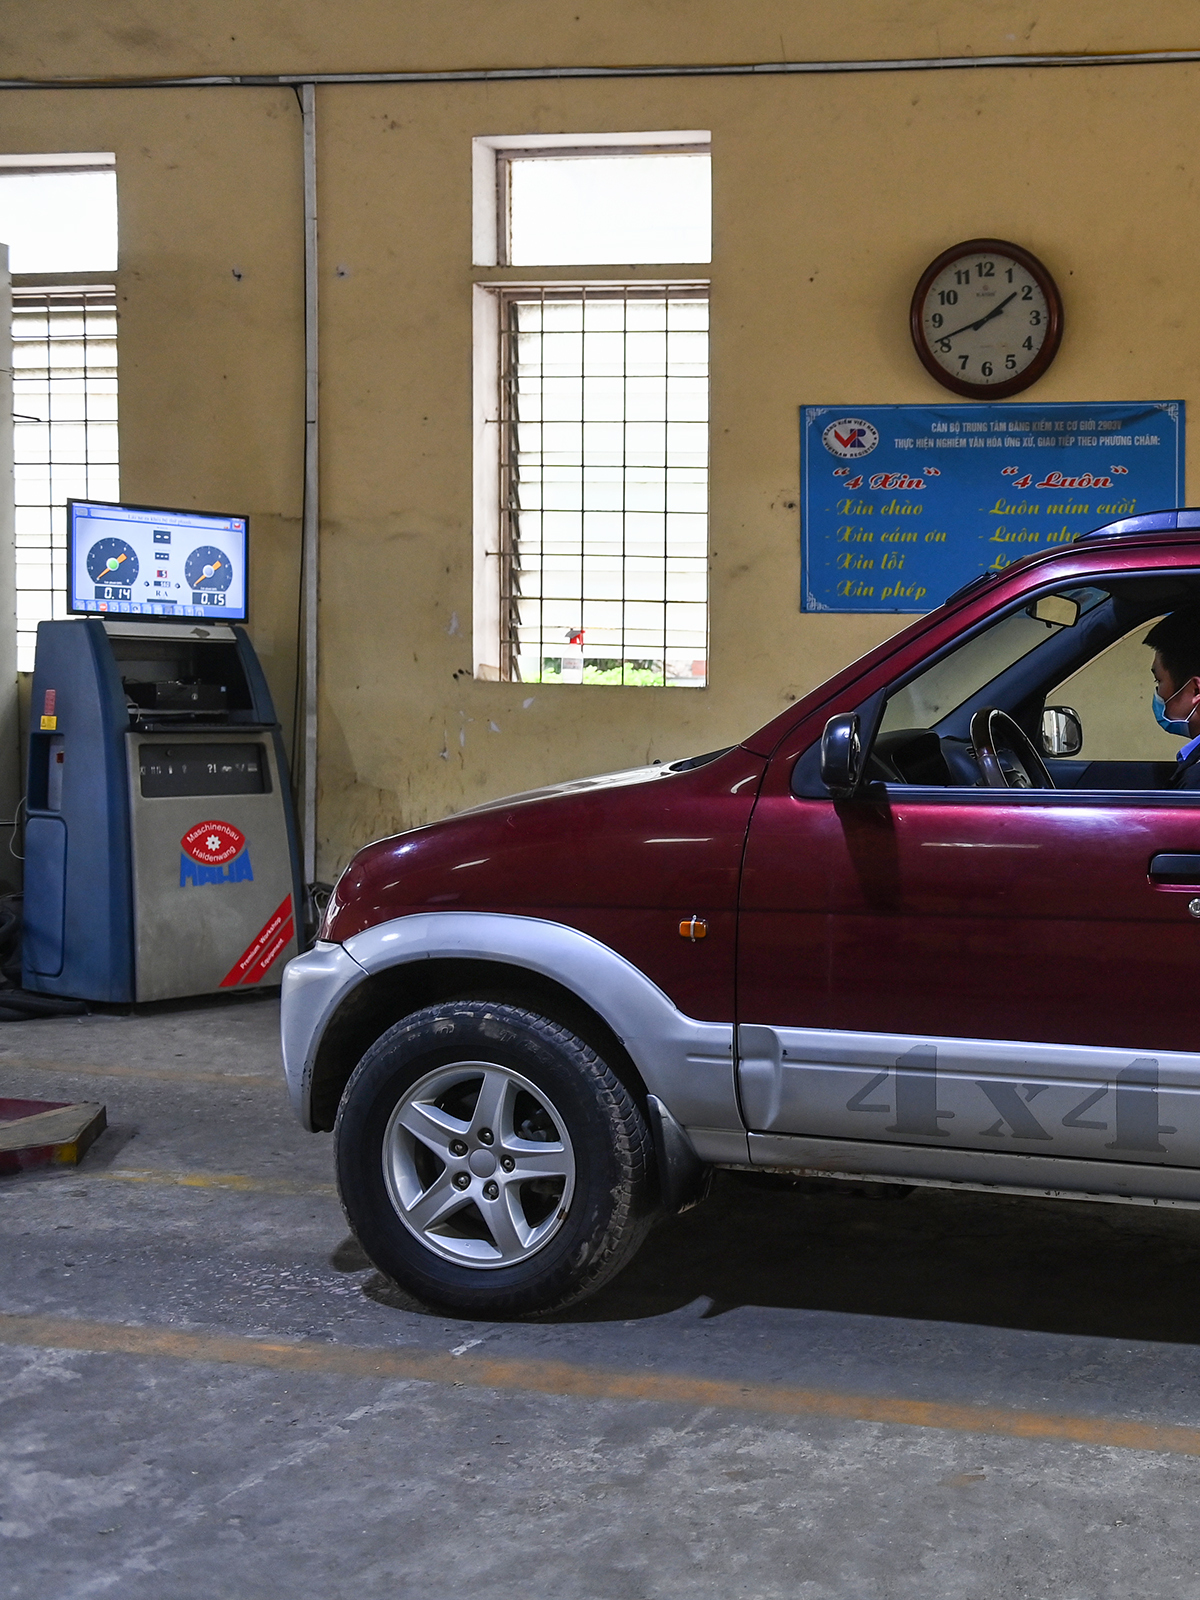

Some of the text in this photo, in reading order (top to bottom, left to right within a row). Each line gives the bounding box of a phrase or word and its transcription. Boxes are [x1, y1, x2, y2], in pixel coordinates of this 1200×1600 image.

[955, 269, 970, 285] 11
[975, 261, 995, 277] 12
[1005, 268, 1013, 283] 1
[938, 290, 958, 306] 10
[1021, 285, 1033, 301] 2
[932, 313, 944, 328] 9
[1029, 310, 1041, 326] 3
[939, 337, 952, 353] 8
[1022, 335, 1033, 351] 4
[958, 355, 969, 370] 7
[981, 361, 993, 377] 6
[1005, 354, 1017, 369] 5
[962, 421, 988, 432] TRUNG
[1054, 420, 1064, 431] XE
[1037, 436, 1056, 447] GIAO
[1077, 436, 1097, 446] THEO
[836, 498, 923, 515] Xin chào
[989, 497, 1137, 515] Luôn mím cười
[836, 525, 947, 542] Xin cám ơn
[989, 526, 1040, 542] Luôn
[836, 551, 906, 570] Xin lỗi
[104, 587, 130, 599] 0.14
[836, 579, 927, 601] Xin phép
[201, 593, 225, 605] 0.15
[187, 822, 239, 843] Maschinenbau
[192, 845, 236, 862] Haldenwang
[240, 916, 282, 970] Premium Workshop
[260, 938, 284, 968] Equipment
[846, 1044, 1178, 1154] 4x4
